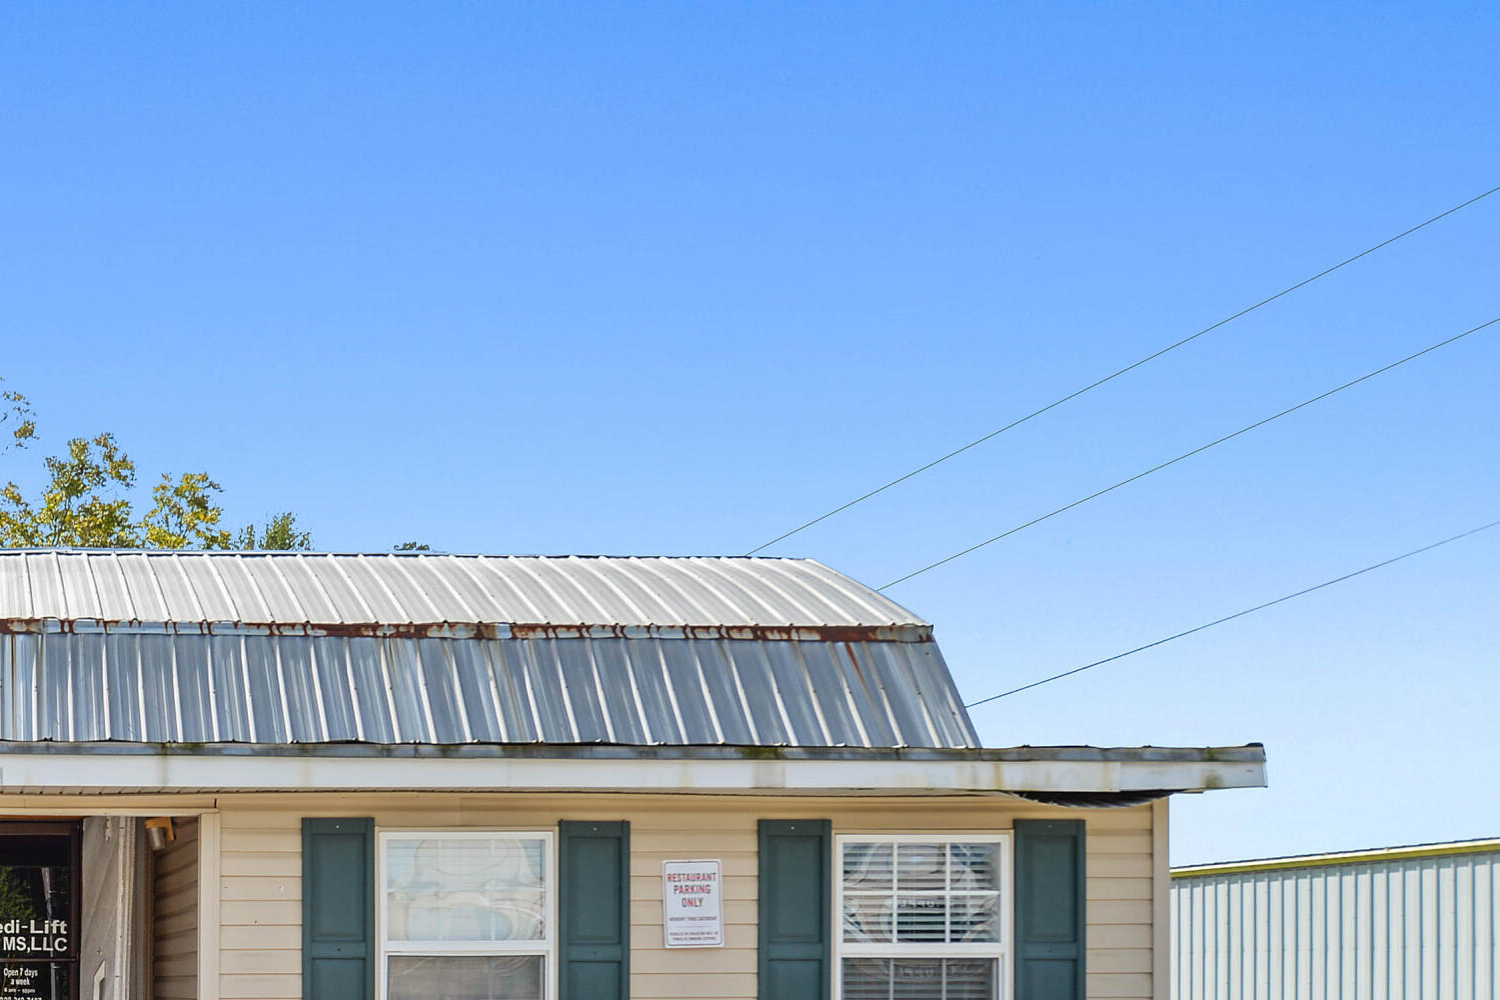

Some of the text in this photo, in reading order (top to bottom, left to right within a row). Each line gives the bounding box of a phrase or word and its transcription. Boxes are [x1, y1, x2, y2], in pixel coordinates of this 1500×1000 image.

[667, 873, 717, 882] RESTAURANT
[673, 884, 711, 895] PARKING
[682, 897, 704, 908] ONLY
[3, 936, 68, 953] MS,LLC
[3, 967, 38, 978] Open 7 days
[16, 977, 30, 985] week
